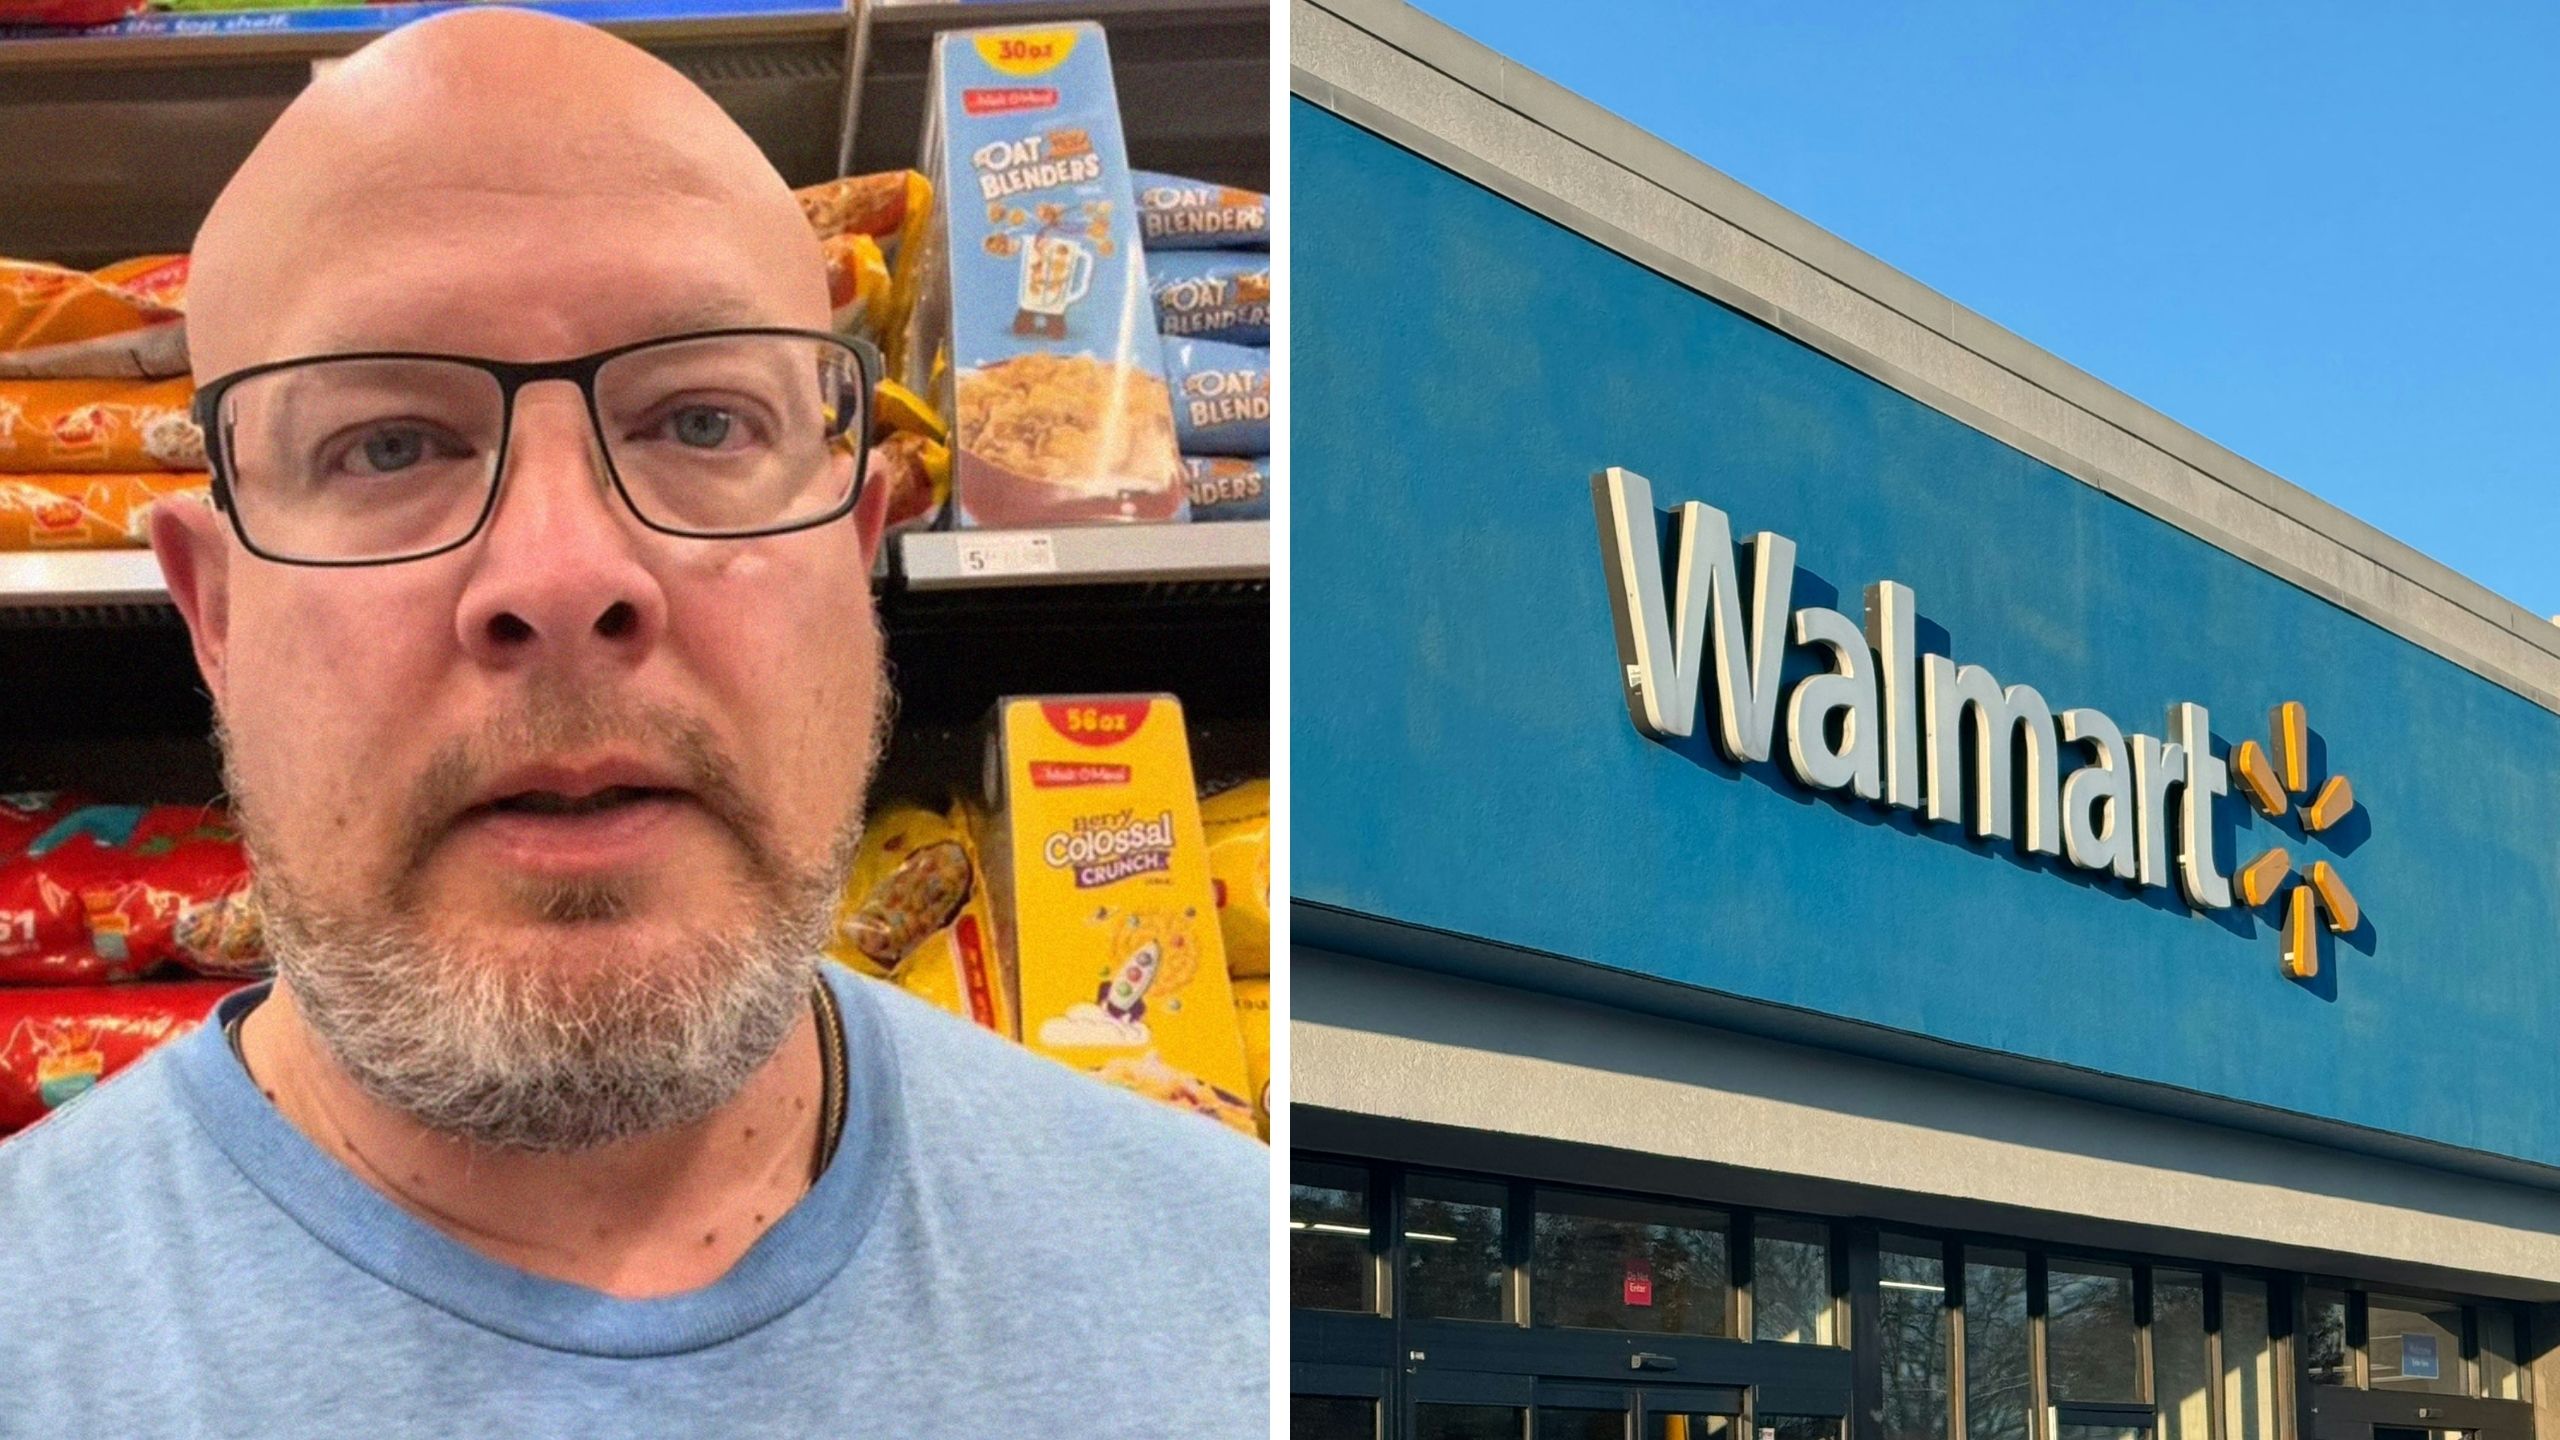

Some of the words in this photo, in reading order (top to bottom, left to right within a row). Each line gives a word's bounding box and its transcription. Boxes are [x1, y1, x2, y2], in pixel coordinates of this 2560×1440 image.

[974, 135, 1042, 170] OAT
[979, 152, 1101, 200] BLENDERS
[1143, 187, 1210, 210] OAT
[1146, 205, 1266, 238] BLENDERS
[1161, 279, 1229, 312] OAT
[1184, 370, 1256, 397] OAT
[1190, 396, 1270, 428] BLEND
[1592, 466, 2232, 909] Walmart
[1044, 811, 1173, 869] Colossal
[1080, 852, 1159, 887] CRUNCH
[1629, 1282, 1647, 1293] Enter
